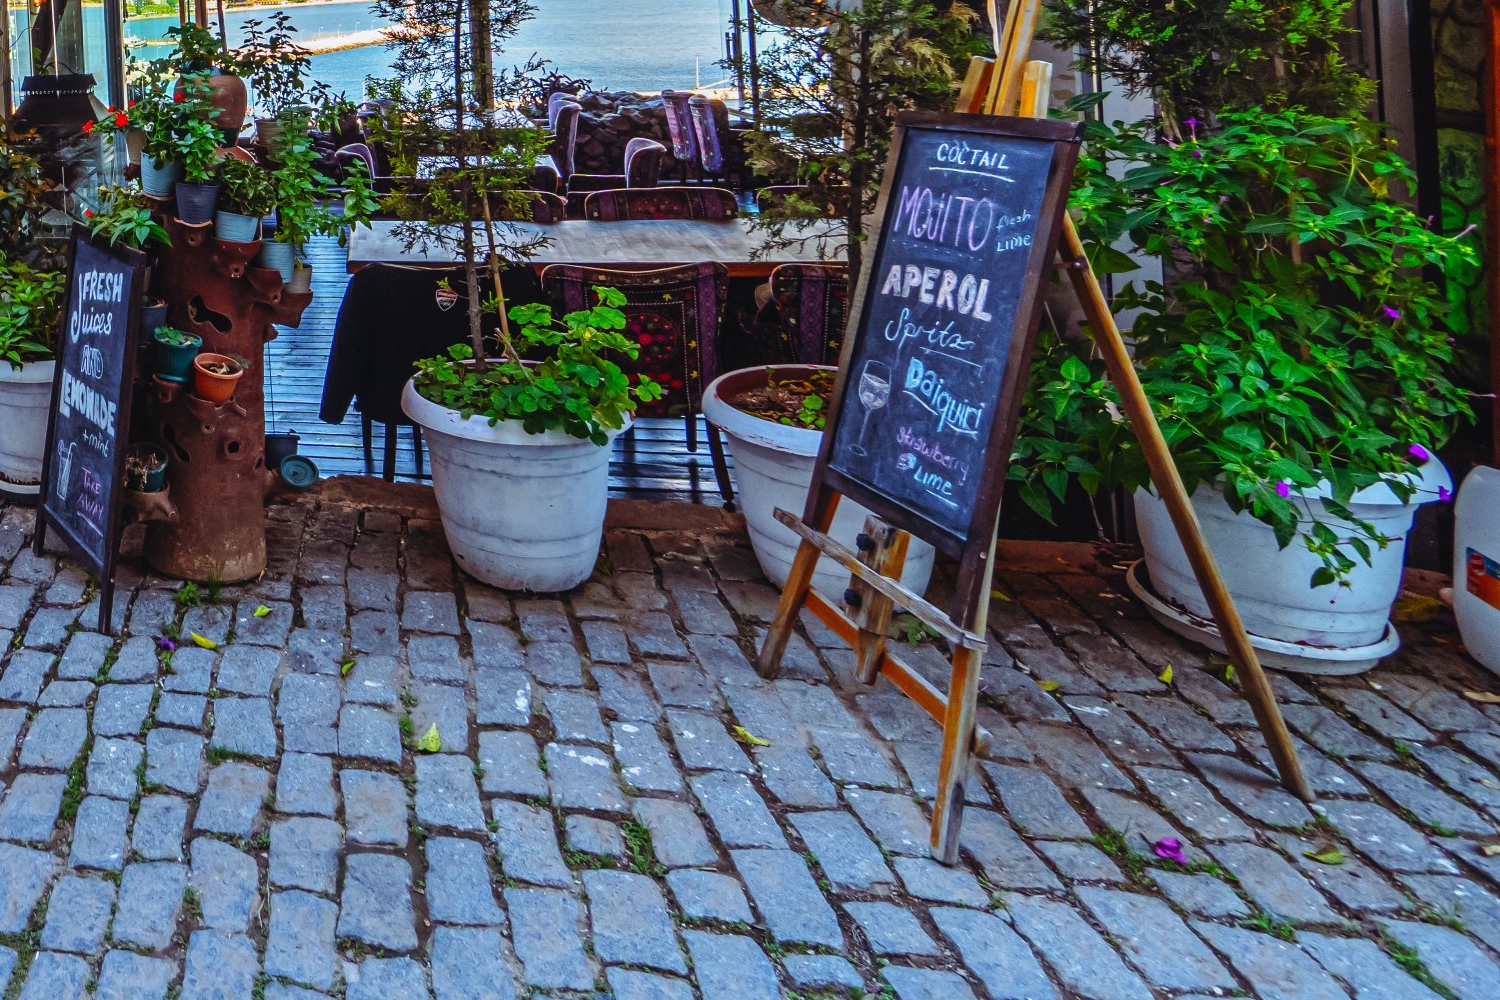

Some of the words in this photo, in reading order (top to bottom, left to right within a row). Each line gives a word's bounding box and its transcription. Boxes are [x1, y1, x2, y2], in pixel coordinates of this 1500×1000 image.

[893, 185, 994, 251] MOJITO
[70, 273, 113, 343] Juices
[82, 269, 124, 303] FRESH
[880, 263, 993, 322] APEROL
[80, 345, 104, 379] AND
[59, 368, 117, 437] LEMONADE
[76, 493, 104, 520] AWAY
